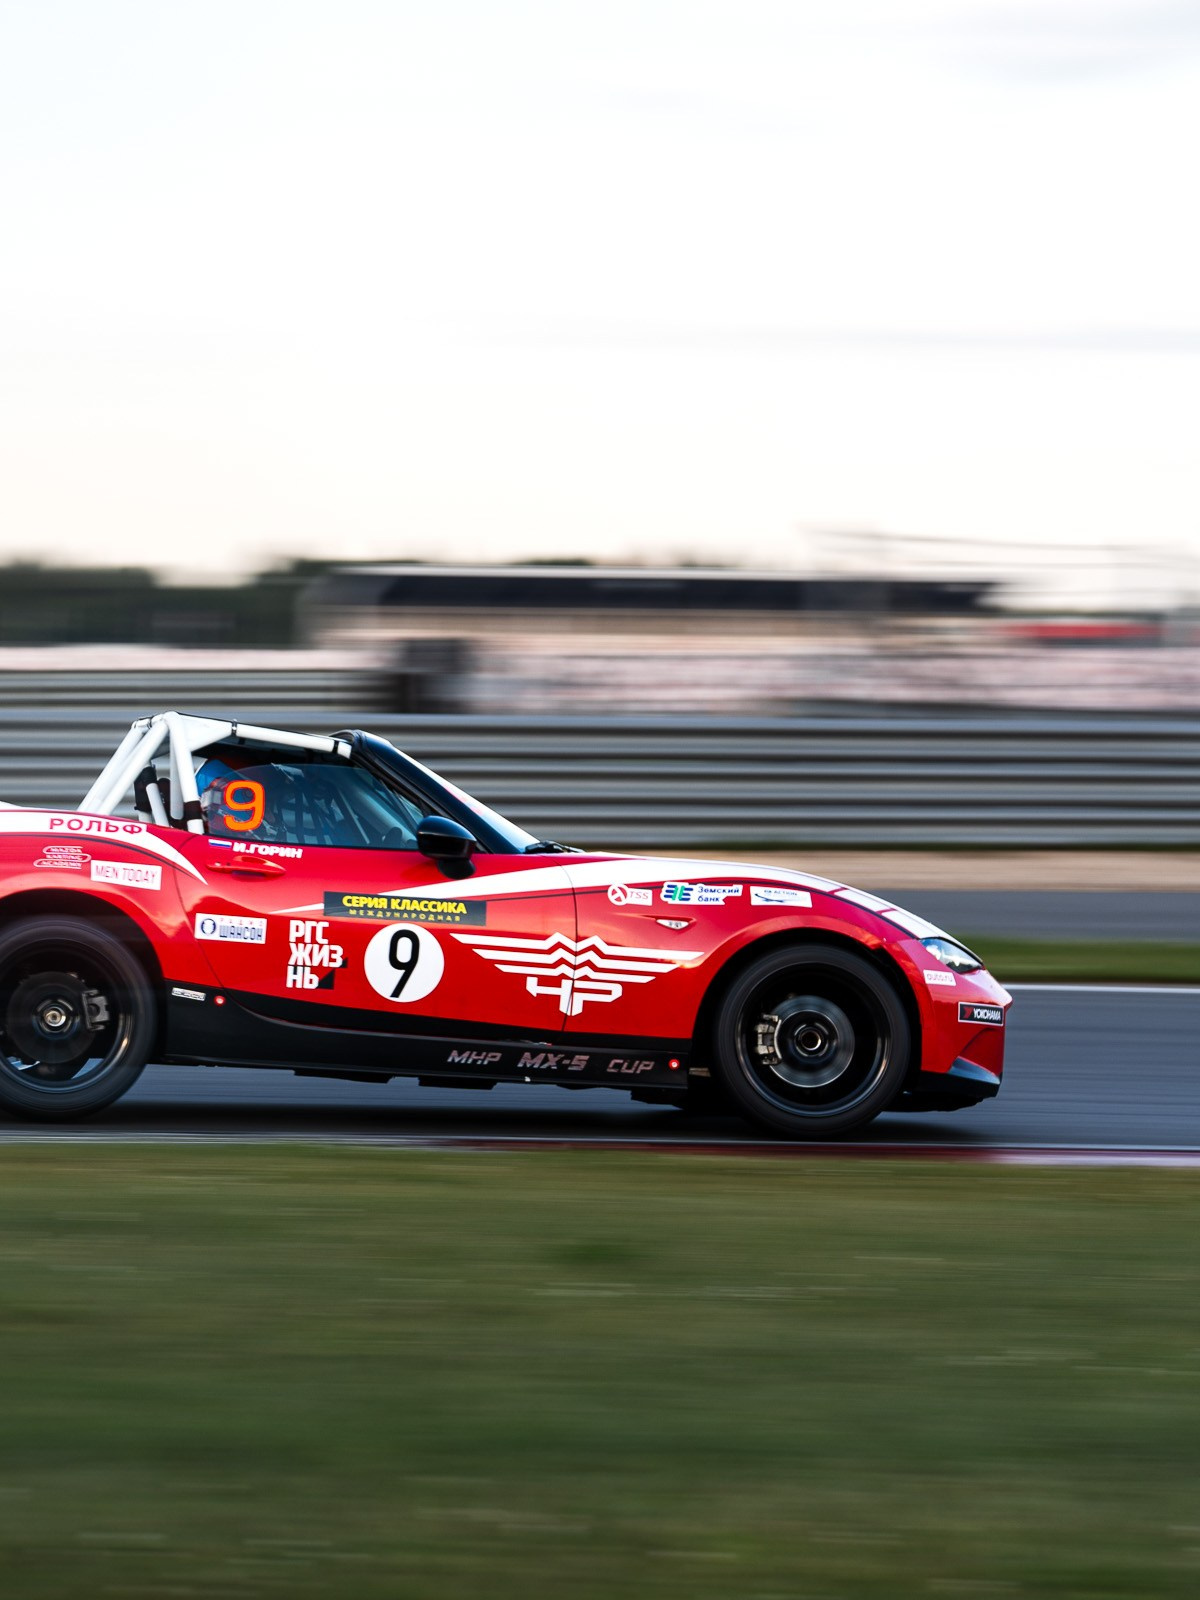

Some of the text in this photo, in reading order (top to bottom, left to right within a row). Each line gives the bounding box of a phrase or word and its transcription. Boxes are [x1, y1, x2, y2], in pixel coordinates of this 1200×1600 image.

[224, 780, 265, 832] 9
[49, 818, 142, 834] РОЛЬФ
[233, 842, 303, 858] И.ГОРИН
[95, 865, 158, 883] MEN TODAY
[628, 890, 649, 900] TSS
[697, 886, 740, 895] Земский
[697, 895, 720, 903] банк
[342, 895, 467, 914] СЕРИЯ КЛАССИКА
[349, 909, 461, 921] МЕЖДУНАРОДНАЯ
[219, 925, 263, 941] ШАНСОН
[289, 920, 329, 944] РГС
[288, 943, 343, 968] ЖИЗ
[388, 929, 420, 998] 9
[286, 966, 319, 989] НЬ
[973, 1008, 1002, 1021] YOKOHAMA
[517, 1052, 590, 1071] MX-5
[606, 1059, 655, 1074] CUP
